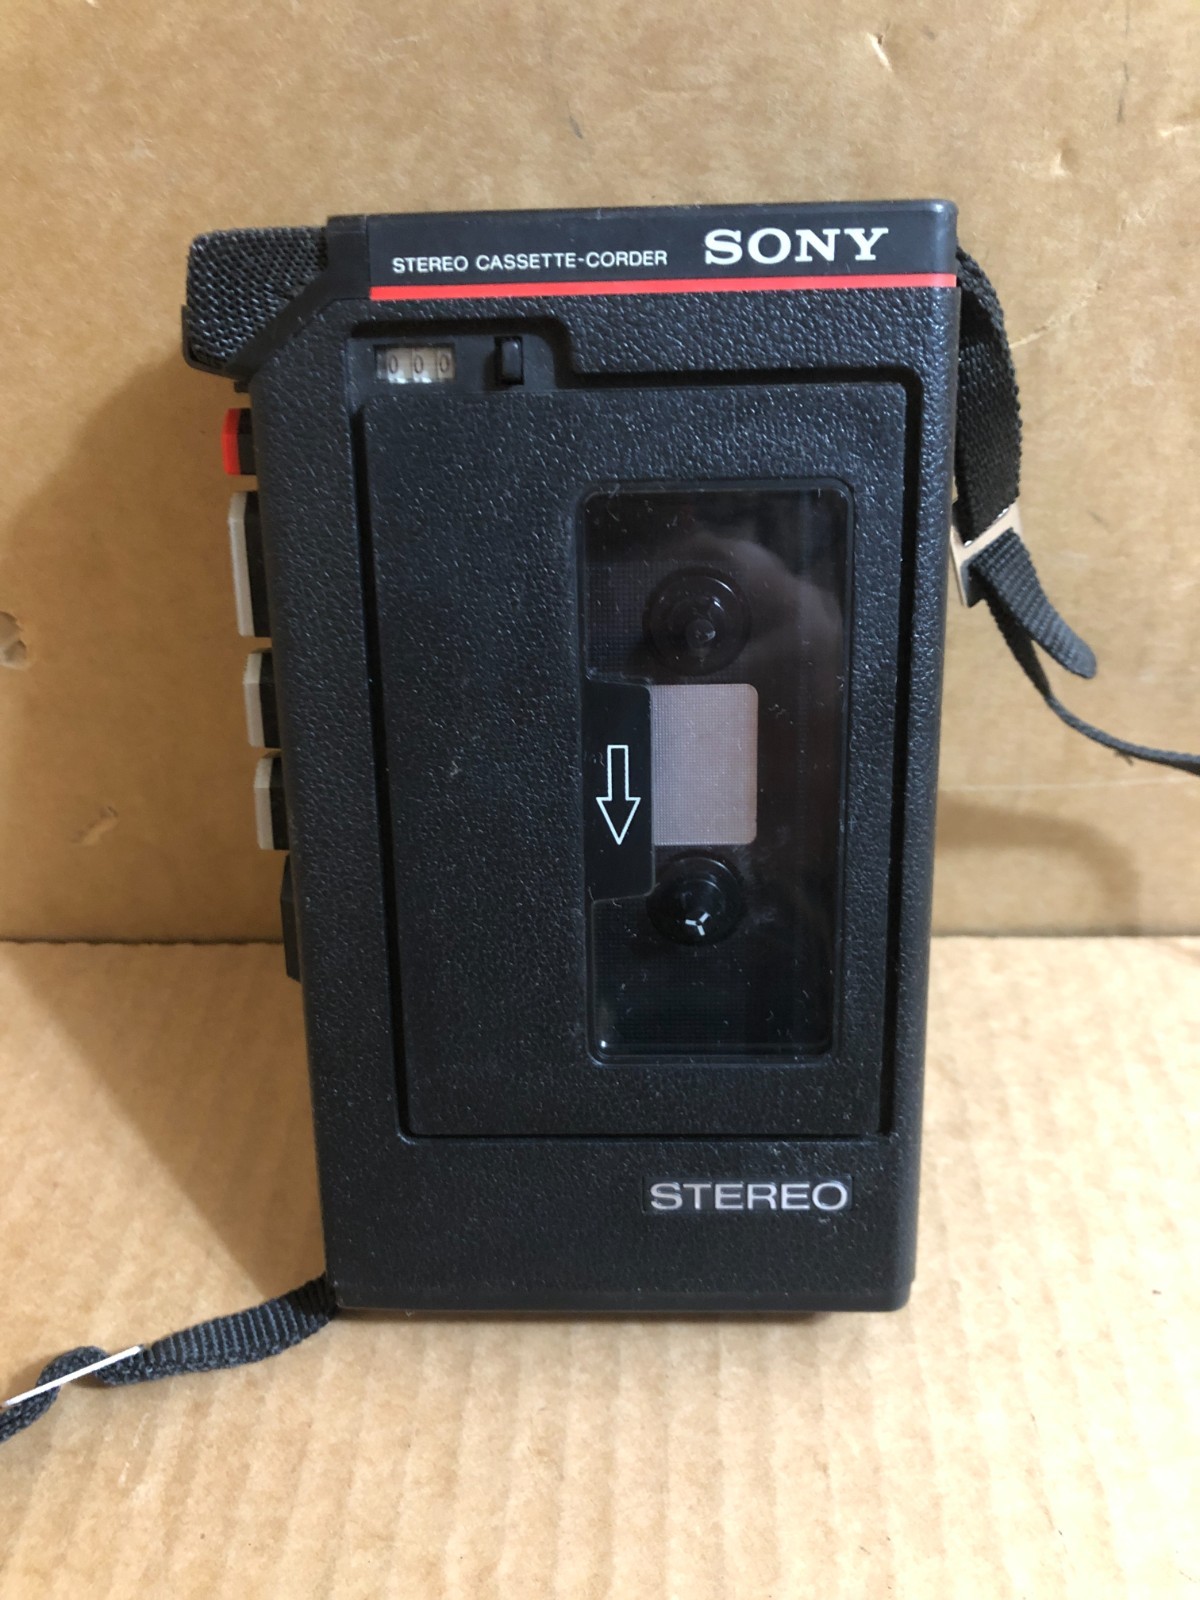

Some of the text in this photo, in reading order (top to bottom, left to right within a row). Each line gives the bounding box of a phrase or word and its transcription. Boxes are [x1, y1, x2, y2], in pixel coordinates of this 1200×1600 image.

[704, 227, 889, 266] SONY
[392, 250, 669, 274] STEREO CASSETTE-CORDER
[650, 1182, 849, 1211] STEREO
